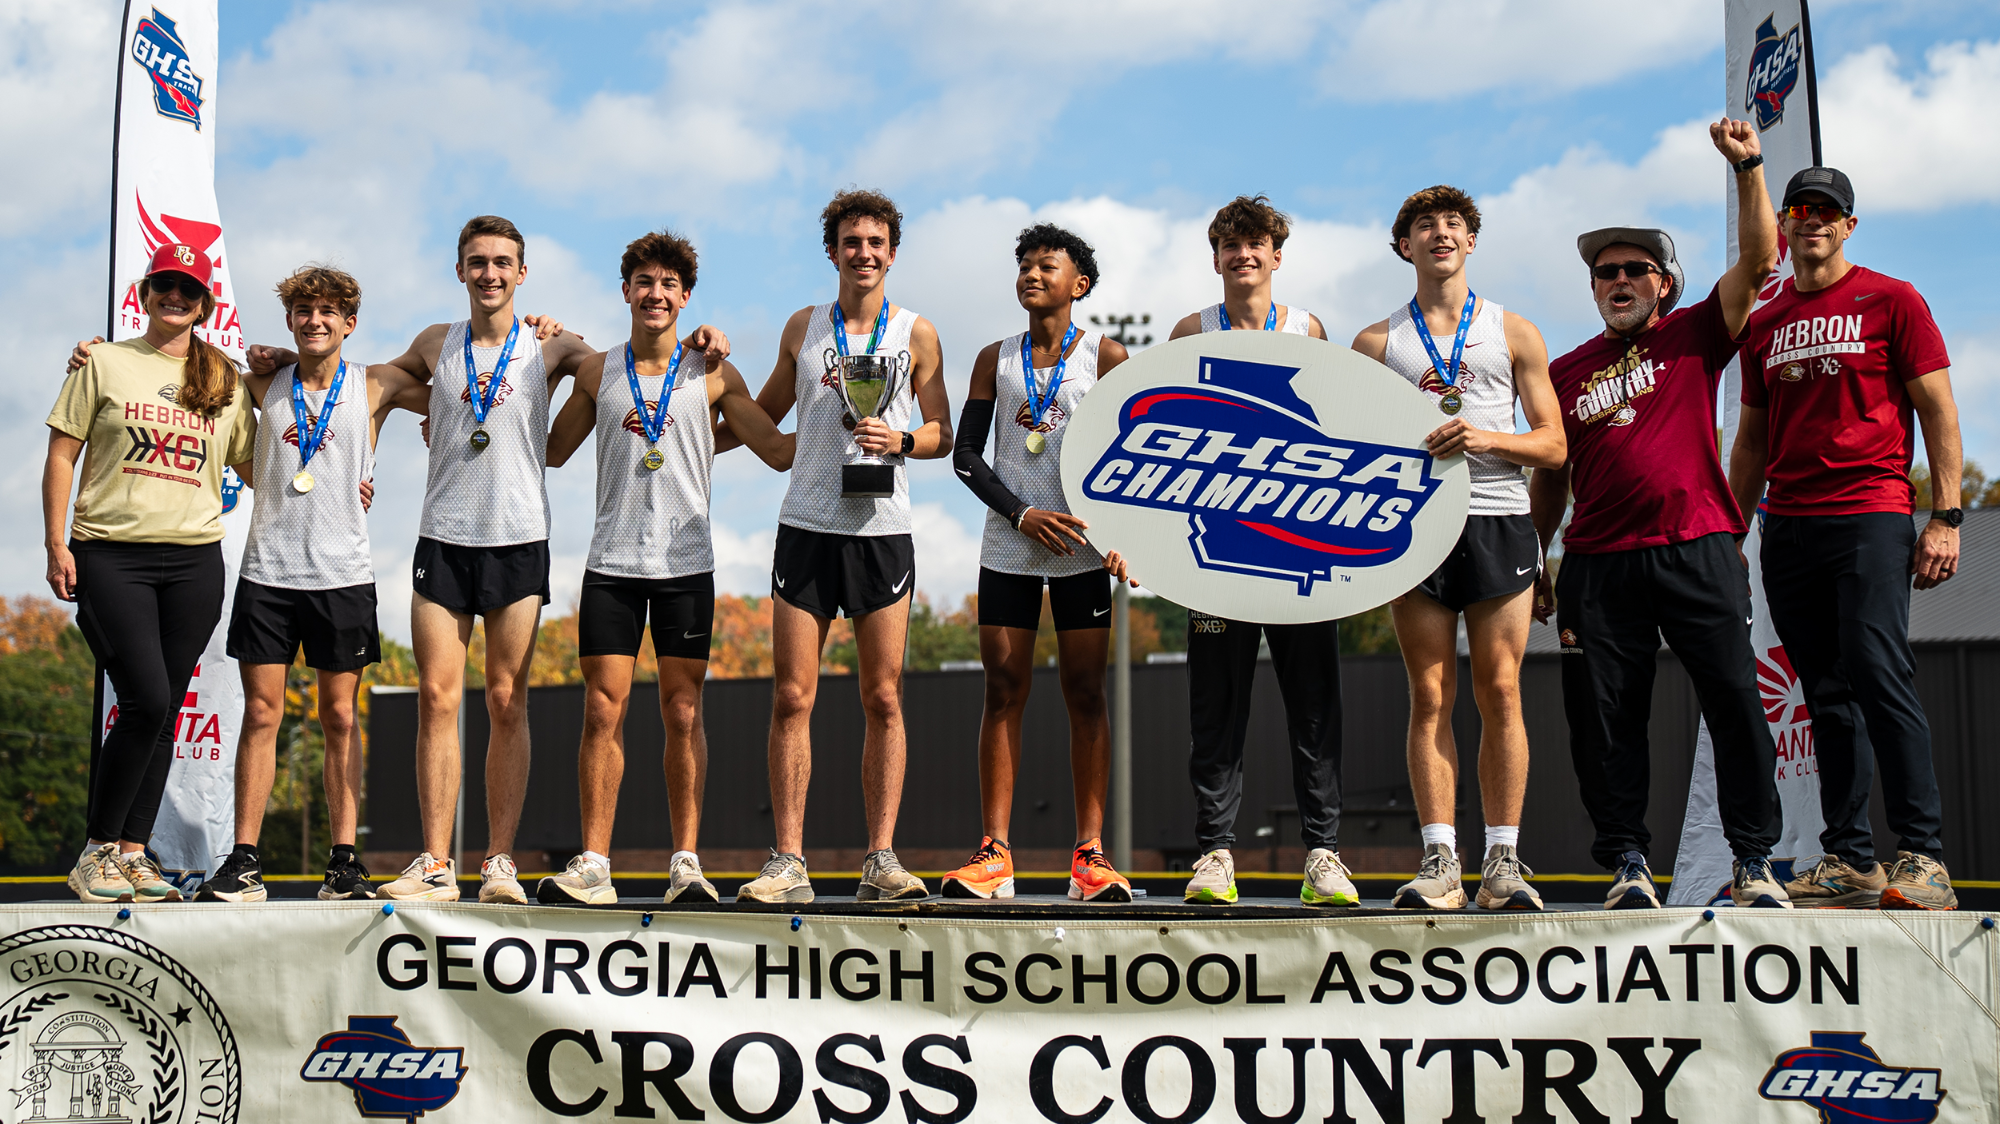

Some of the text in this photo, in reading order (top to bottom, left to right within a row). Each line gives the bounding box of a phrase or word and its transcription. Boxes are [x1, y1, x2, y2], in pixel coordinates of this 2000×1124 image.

[1747, 31, 1799, 107] GHSA
[1770, 315, 1863, 356] HEBRON
[1769, 344, 1862, 367] CROSS COUNTRY
[125, 402, 215, 436] HEBRON
[147, 428, 199, 472] XC
[1121, 422, 1428, 493] GHSA
[1090, 459, 1413, 532] CHAMPIONS
[176, 746, 220, 760] LUB
[1796, 759, 1819, 777] CLU
[10, 950, 160, 1001] GEORGIA
[375, 933, 1861, 1006] GEORGIA HIGH SCHOOL ASSOCIATION
[47, 1014, 111, 1035] CONSTITUTION
[28, 1065, 47, 1077] WIS
[60, 1061, 96, 1072] JUSTICE
[106, 1064, 132, 1080] MODER
[304, 1052, 459, 1079] GHSA
[526, 1028, 1703, 1124] CROSS COUNTRY
[26, 1081, 47, 1095] DOM
[107, 1080, 132, 1096] ATION
[1766, 1069, 1939, 1101] GHSA
